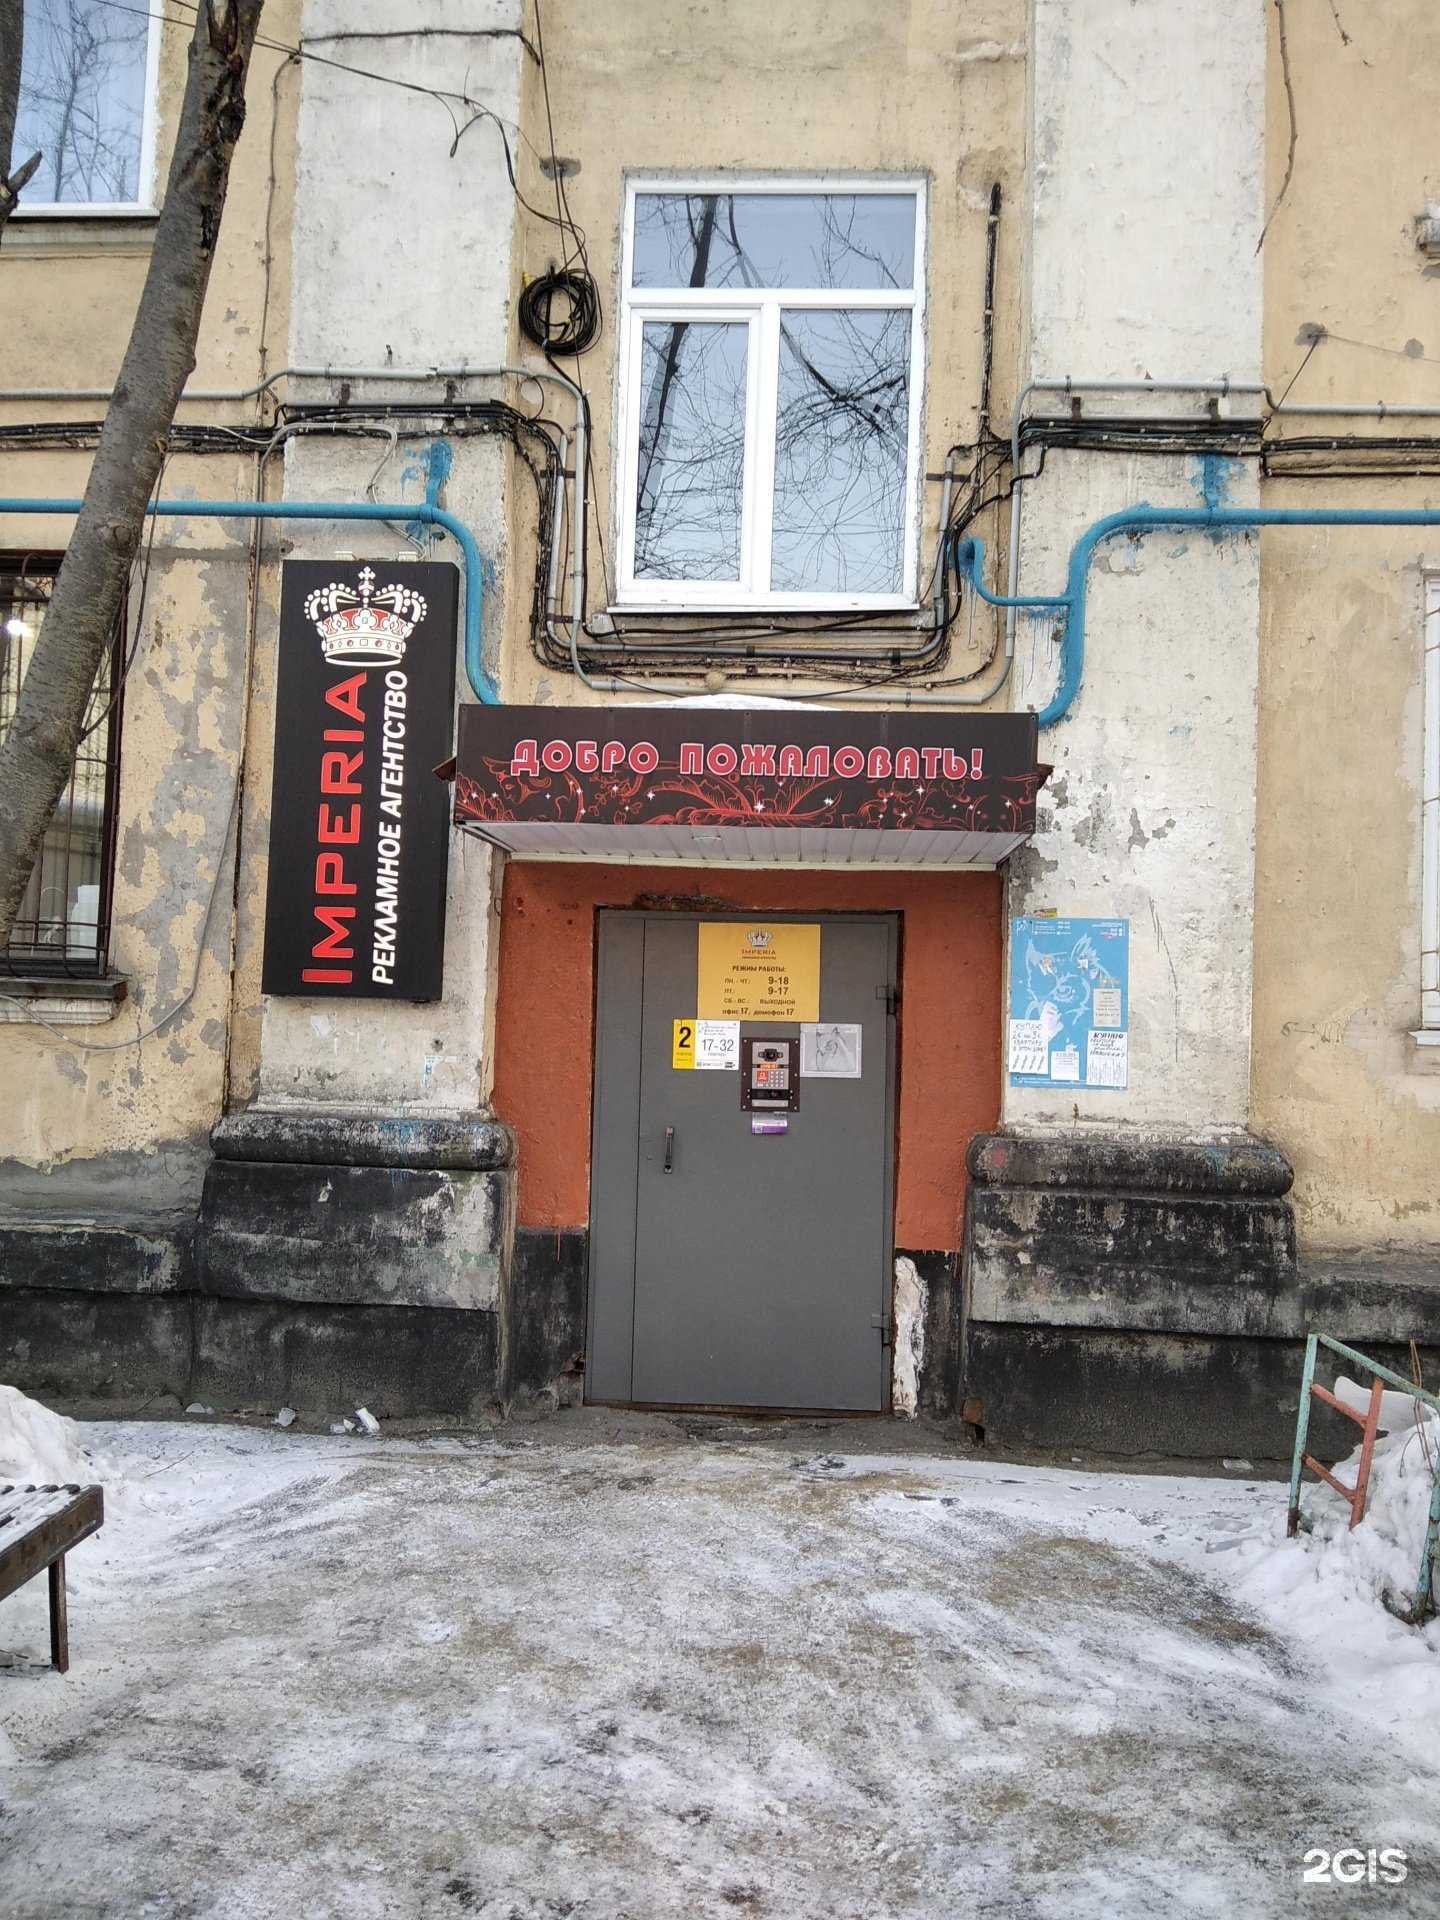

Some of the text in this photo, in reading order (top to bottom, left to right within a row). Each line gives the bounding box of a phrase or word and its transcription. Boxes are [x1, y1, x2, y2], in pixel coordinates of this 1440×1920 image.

[510, 738, 984, 781] ДОБРО ПОЖАЛОВАТЬ!
[302, 671, 368, 983] IMPERIA
[372, 670, 408, 985] РЕКЛАМНОЕ АГЕНТСТВО
[768, 976, 790, 985] 9-18
[767, 986, 789, 995] 9-17
[786, 1008, 795, 1016] 17
[679, 1026, 691, 1048] 2
[703, 1038, 735, 1051] 17-32
